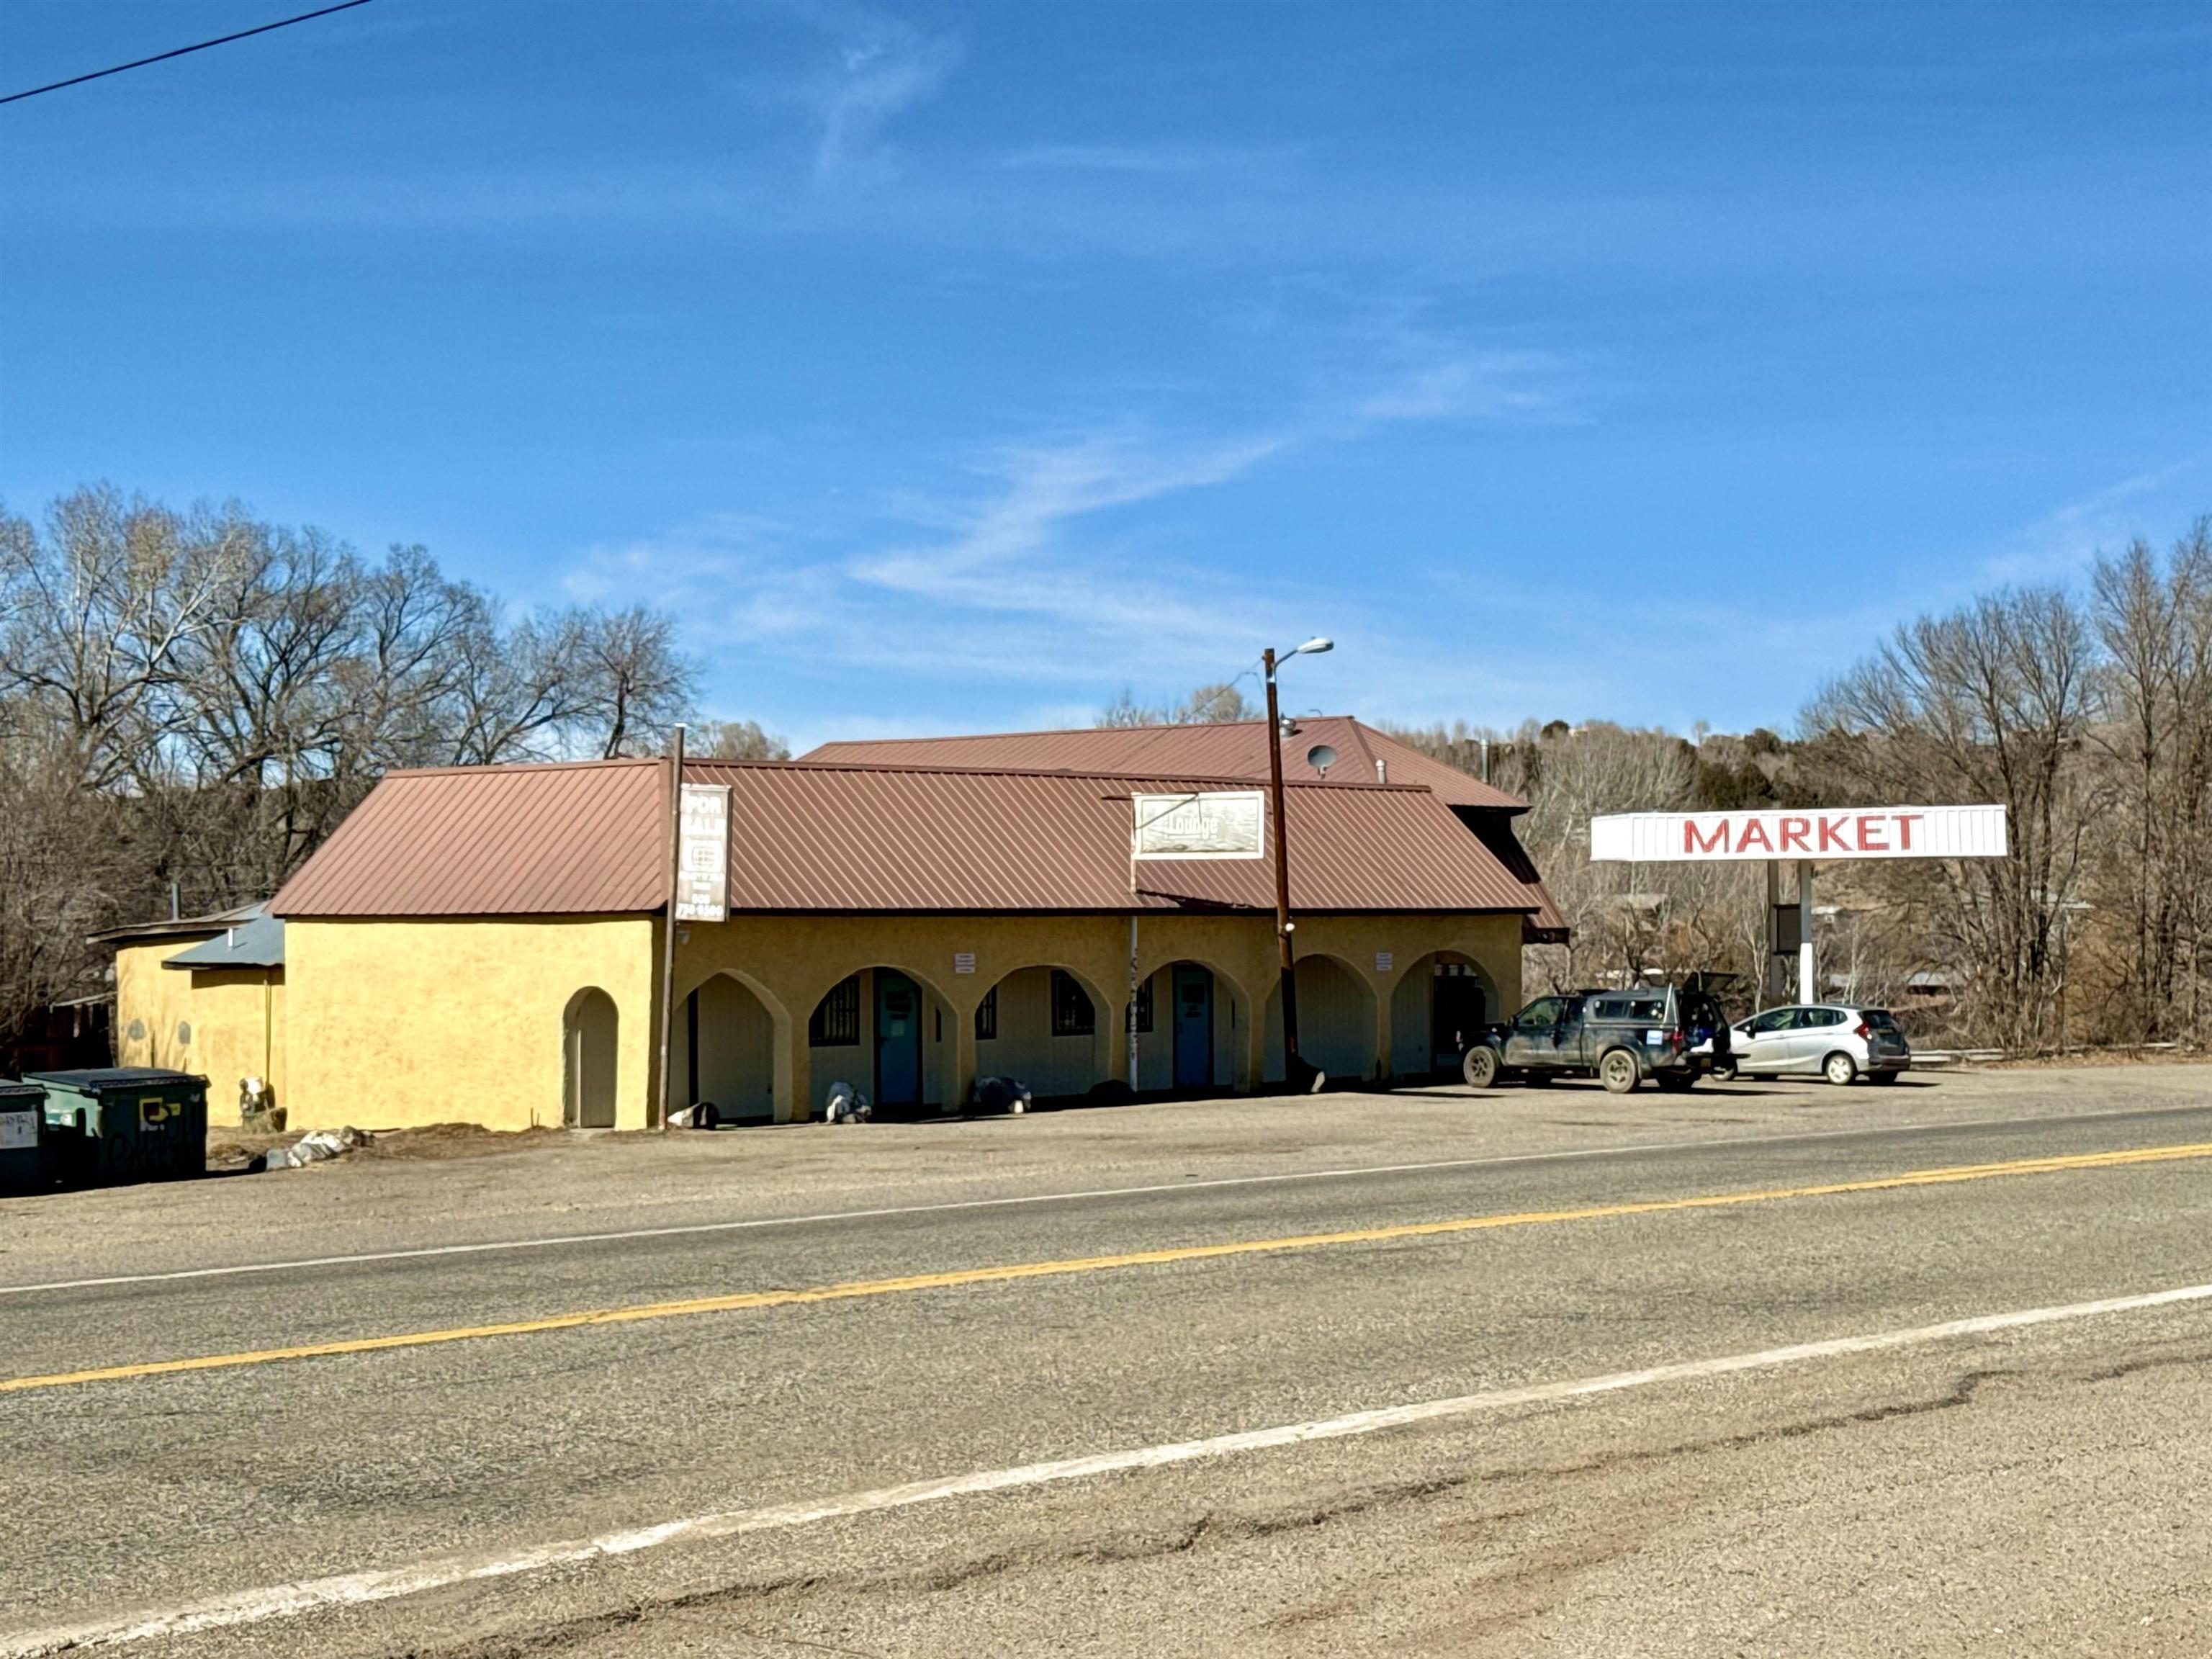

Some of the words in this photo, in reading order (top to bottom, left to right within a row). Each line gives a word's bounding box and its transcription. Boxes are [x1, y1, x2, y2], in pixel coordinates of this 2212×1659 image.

[686, 796, 721, 814] FOR
[682, 814, 726, 835] SALE
[1168, 813, 1219, 840] Lounge
[1684, 814, 1924, 853] MARKET
